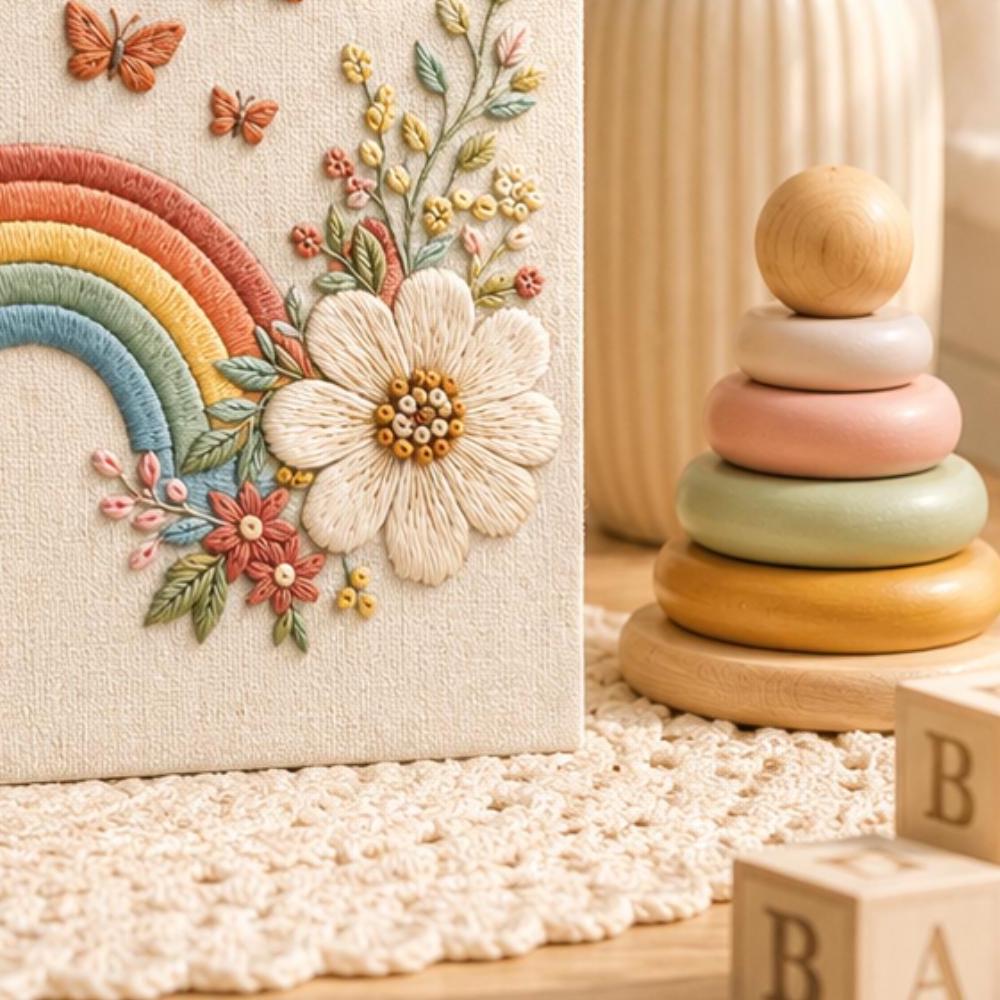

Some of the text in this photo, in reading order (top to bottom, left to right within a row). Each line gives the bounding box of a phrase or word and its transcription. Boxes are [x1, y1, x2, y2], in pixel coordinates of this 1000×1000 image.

[923, 730, 975, 827] B
[763, 907, 822, 1000] B
[906, 924, 967, 1000] A
